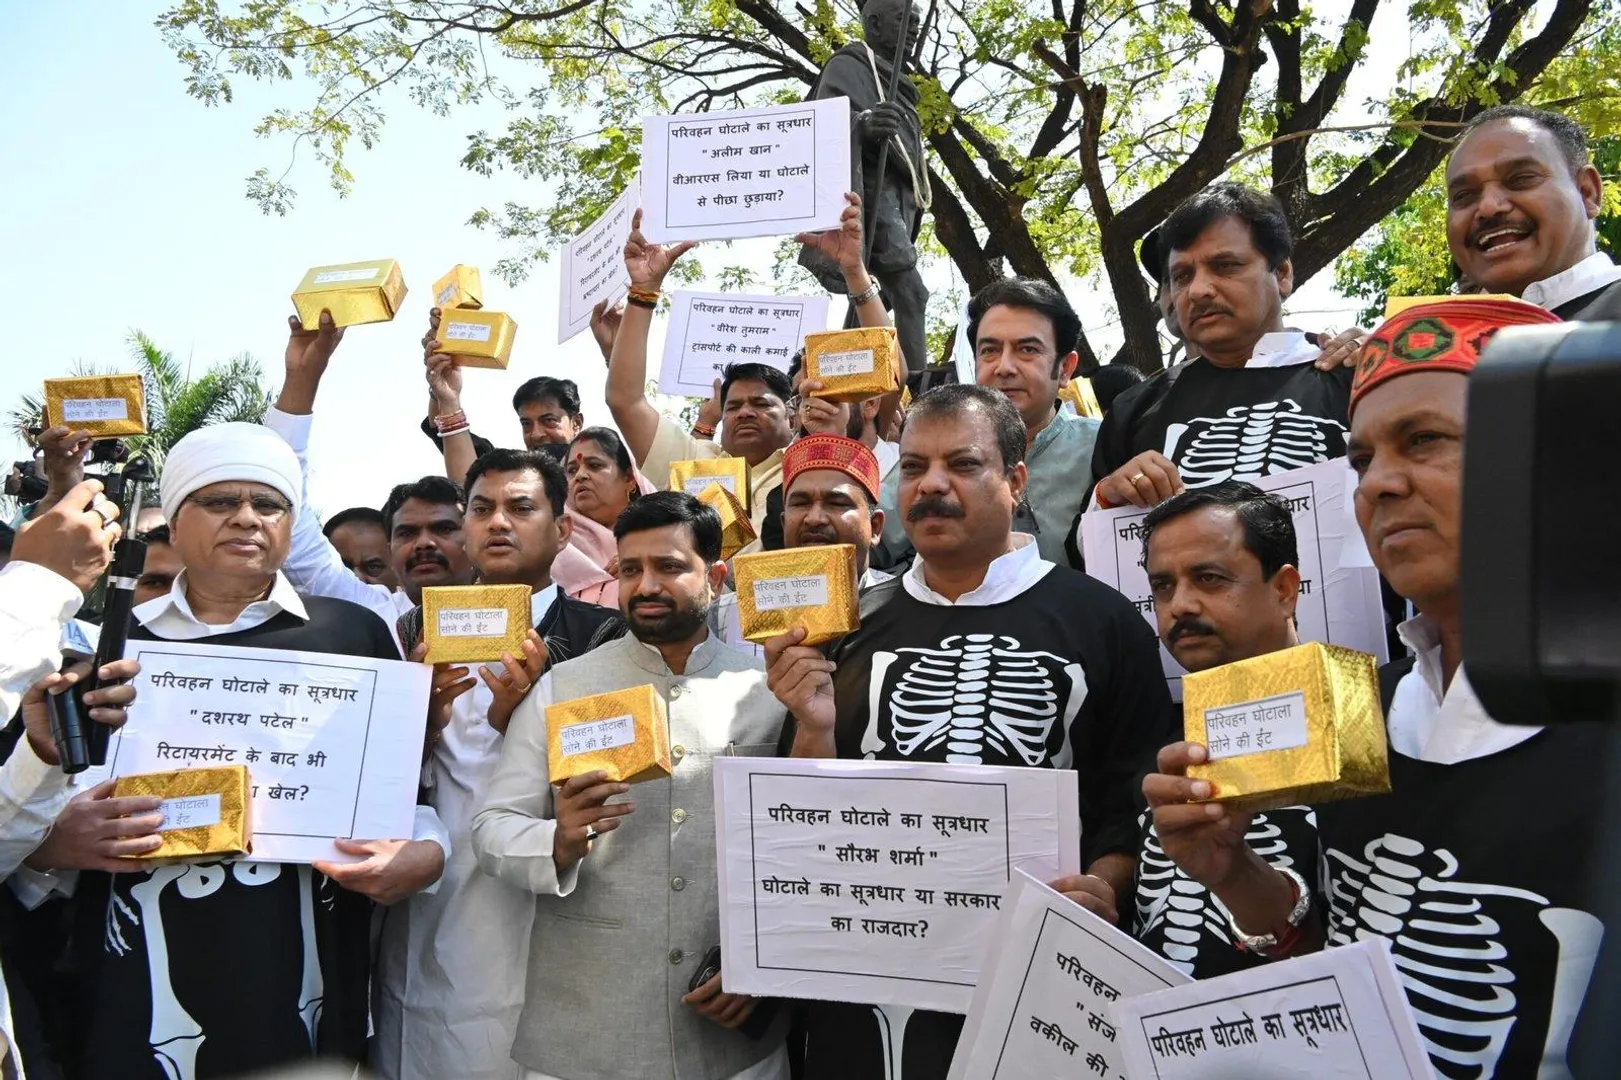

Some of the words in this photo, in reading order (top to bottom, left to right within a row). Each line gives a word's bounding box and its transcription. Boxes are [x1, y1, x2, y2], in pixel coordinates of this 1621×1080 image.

[672, 126, 712, 138] परिवहन
[719, 122, 750, 134] घोटाले
[757, 122, 770, 132] का
[777, 118, 812, 133] सूत्रधार
[673, 173, 720, 185] वीआरएस
[727, 170, 752, 181] लिया
[759, 170, 770, 179] या
[778, 164, 810, 176] घोटाले
[698, 196, 707, 207] से
[714, 194, 738, 206] पीछा
[744, 190, 784, 208] छुड़ाया?
[693, 303, 724, 314] परिवहन
[730, 305, 754, 315] घोटाले
[758, 308, 768, 316] का
[773, 308, 800, 320] सूत्रधार
[726, 344, 736, 353] की
[741, 346, 760, 354] काली
[766, 347, 788, 357] कमाई
[754, 580, 786, 592] परिवहन
[791, 578, 820, 588] घोटाला
[758, 594, 773, 606] सोने
[778, 592, 790, 604] की
[440, 611, 470, 620] परिवहन
[475, 610, 503, 620] घोटाला
[442, 623, 456, 634] सोने
[461, 622, 472, 632] की
[151, 673, 213, 691] परिवहन
[222, 676, 270, 694] घोटाले
[279, 683, 298, 696] का
[308, 684, 358, 704] सूत्रधार
[1207, 713, 1247, 730] परिवहन
[1252, 704, 1291, 722] घोटाला
[562, 726, 593, 740] परिवहन
[598, 719, 626, 732] घोटाला
[562, 742, 580, 752] सोने
[585, 738, 596, 750] की
[1209, 734, 1230, 752] सोने
[1236, 732, 1250, 748] की
[156, 741, 238, 762] रिटायरमेंट
[245, 747, 262, 764] के
[270, 750, 296, 767] बाद
[307, 751, 326, 768] भी
[268, 784, 310, 802] खेल?
[174, 799, 208, 810] घोटाला
[768, 803, 830, 824] परिवहन
[841, 806, 890, 827] घोटाले
[900, 812, 922, 830] का
[932, 815, 989, 836] सूत्रधार
[762, 876, 810, 896] घोटाले
[820, 882, 841, 897] का
[850, 884, 905, 906] सूत्रधार
[915, 889, 934, 905] या
[944, 890, 1002, 910] सरकार
[831, 916, 852, 932] का
[862, 918, 929, 938] राजदार?
[1056, 952, 1122, 1002] परिवहन
[1151, 1027, 1206, 1058] परिवहन
[1212, 1011, 1255, 1048] घोटाले
[1263, 1012, 1288, 1040] का
[1292, 1002, 1347, 1048] सूत्रधार
[1030, 1016, 1079, 1056] वकील
[1086, 1052, 1110, 1078] की
